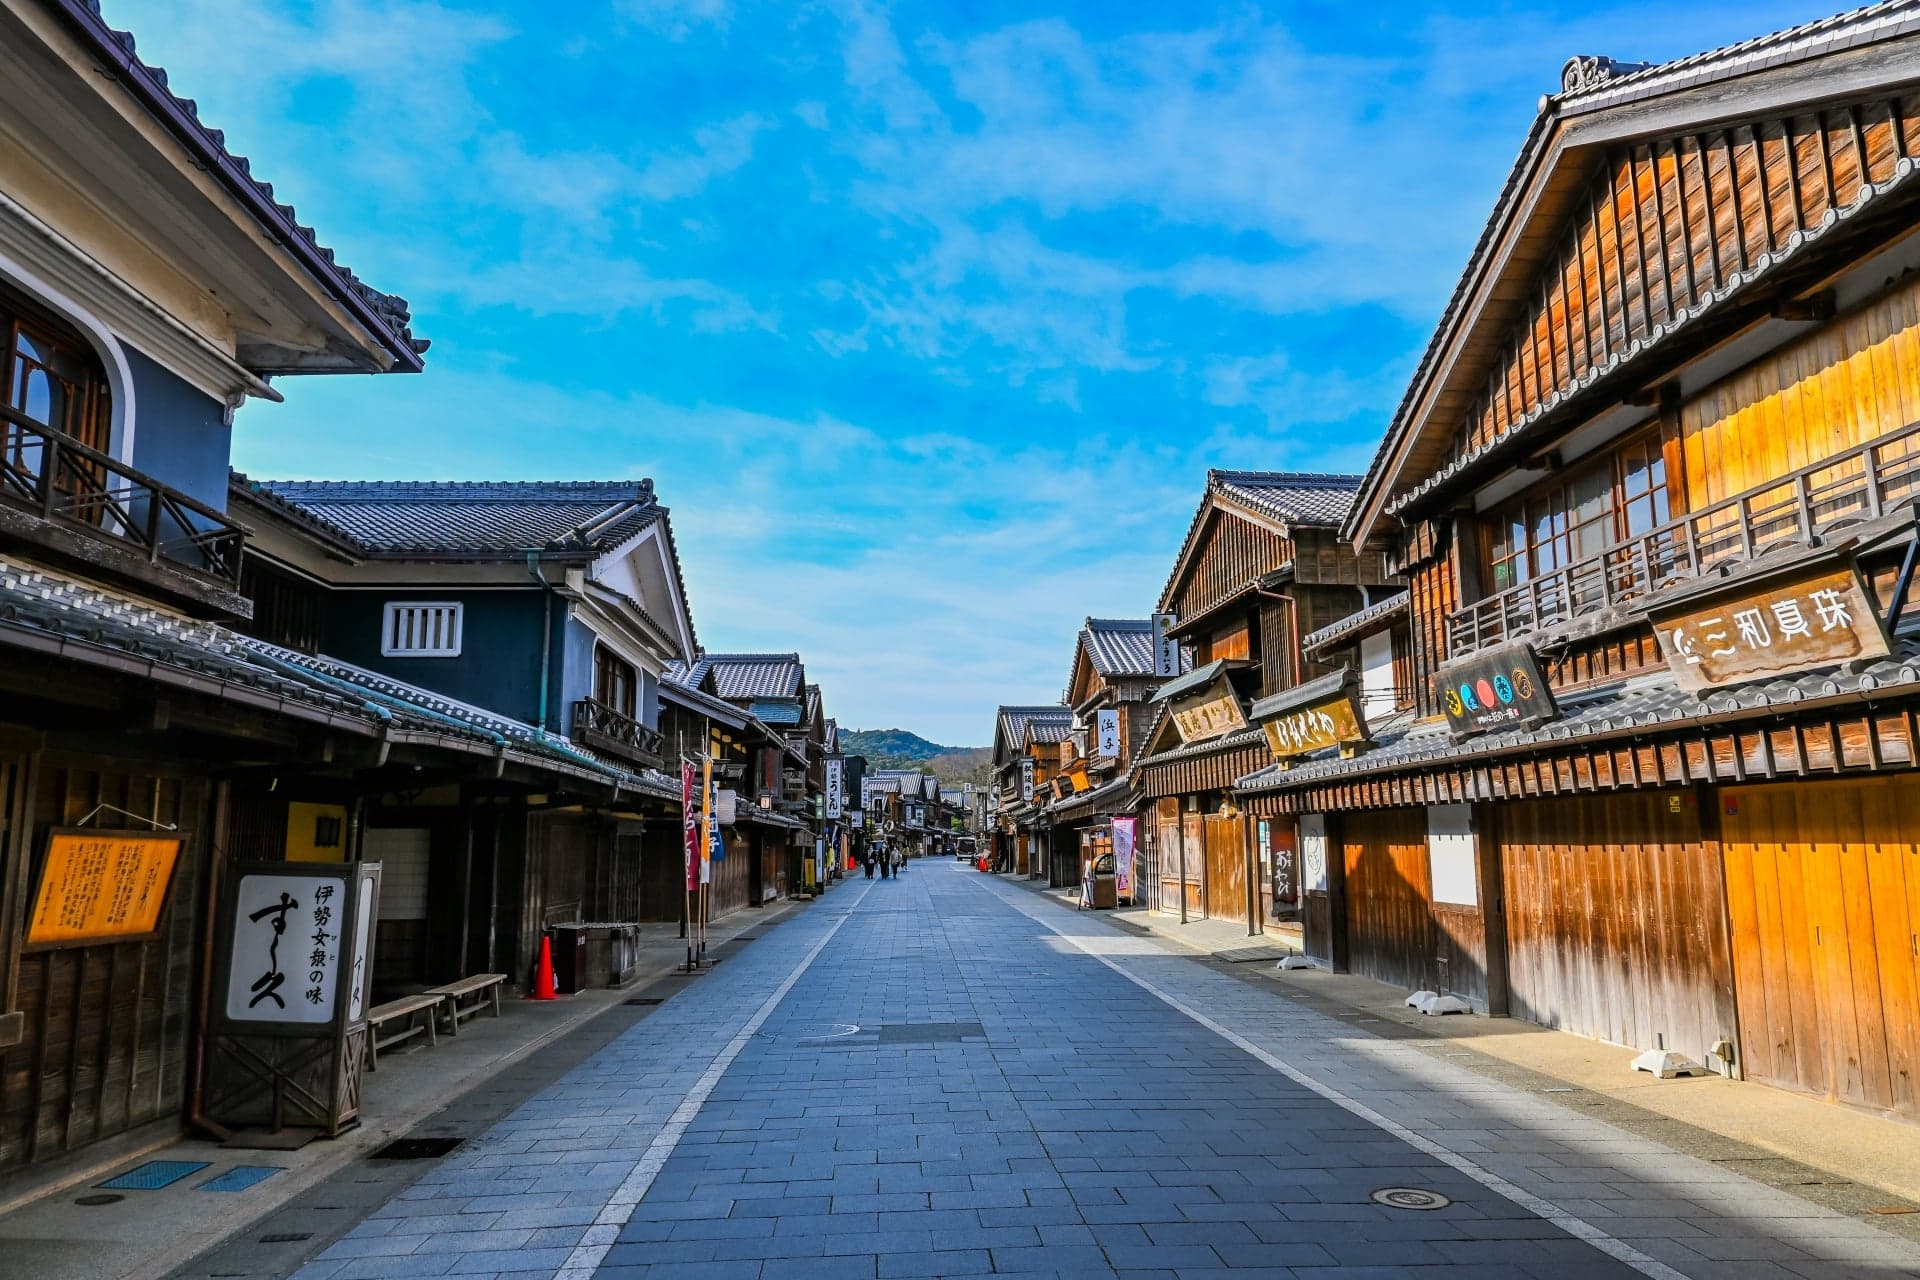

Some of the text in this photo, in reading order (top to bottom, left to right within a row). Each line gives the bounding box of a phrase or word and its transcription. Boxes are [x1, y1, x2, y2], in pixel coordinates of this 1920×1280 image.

[1699, 588, 1853, 658] 三和真珠
[1023, 764, 1032, 793] 松阪牛
[1274, 850, 1289, 896] あわび
[248, 892, 299, 1009] すし久
[305, 885, 335, 1005] 伊勢女衆の味
